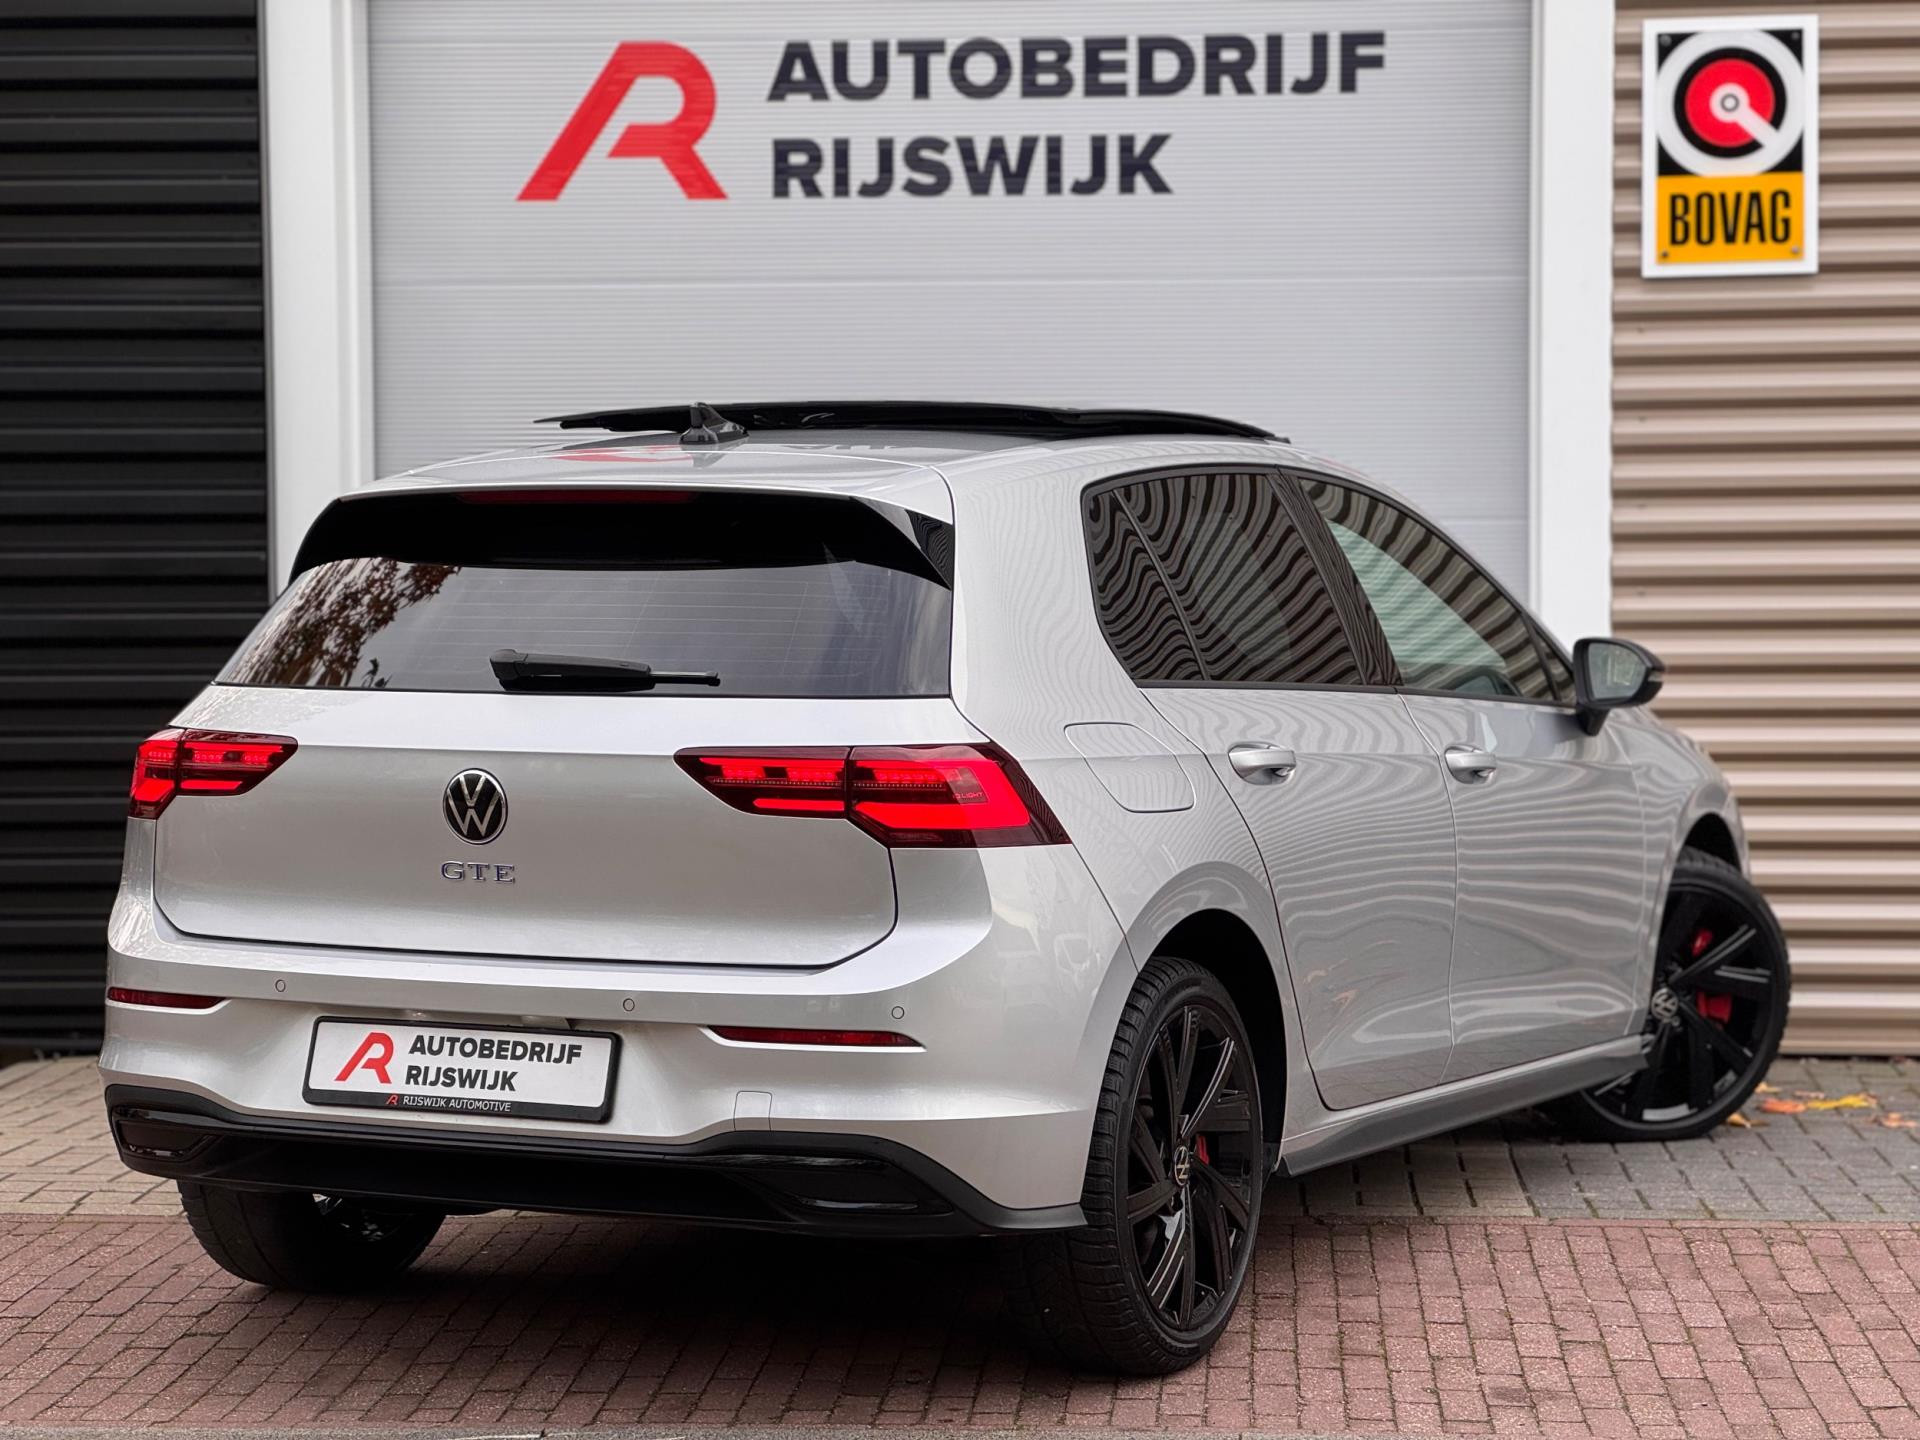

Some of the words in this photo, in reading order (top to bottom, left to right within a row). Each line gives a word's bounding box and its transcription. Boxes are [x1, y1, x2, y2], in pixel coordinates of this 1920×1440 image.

[767, 31, 1386, 102] AUTOBEDRIJF
[772, 133, 1172, 199] RIJSWIJK
[1669, 189, 1791, 246] BOVAG
[441, 860, 515, 883] GTE
[409, 1034, 582, 1065] AUTOBEDRIJF
[405, 1065, 518, 1092] RIJSWIJK
[403, 1095, 447, 1108] RIJSWIJK
[448, 1099, 512, 1112] AUTOMOTIVE
